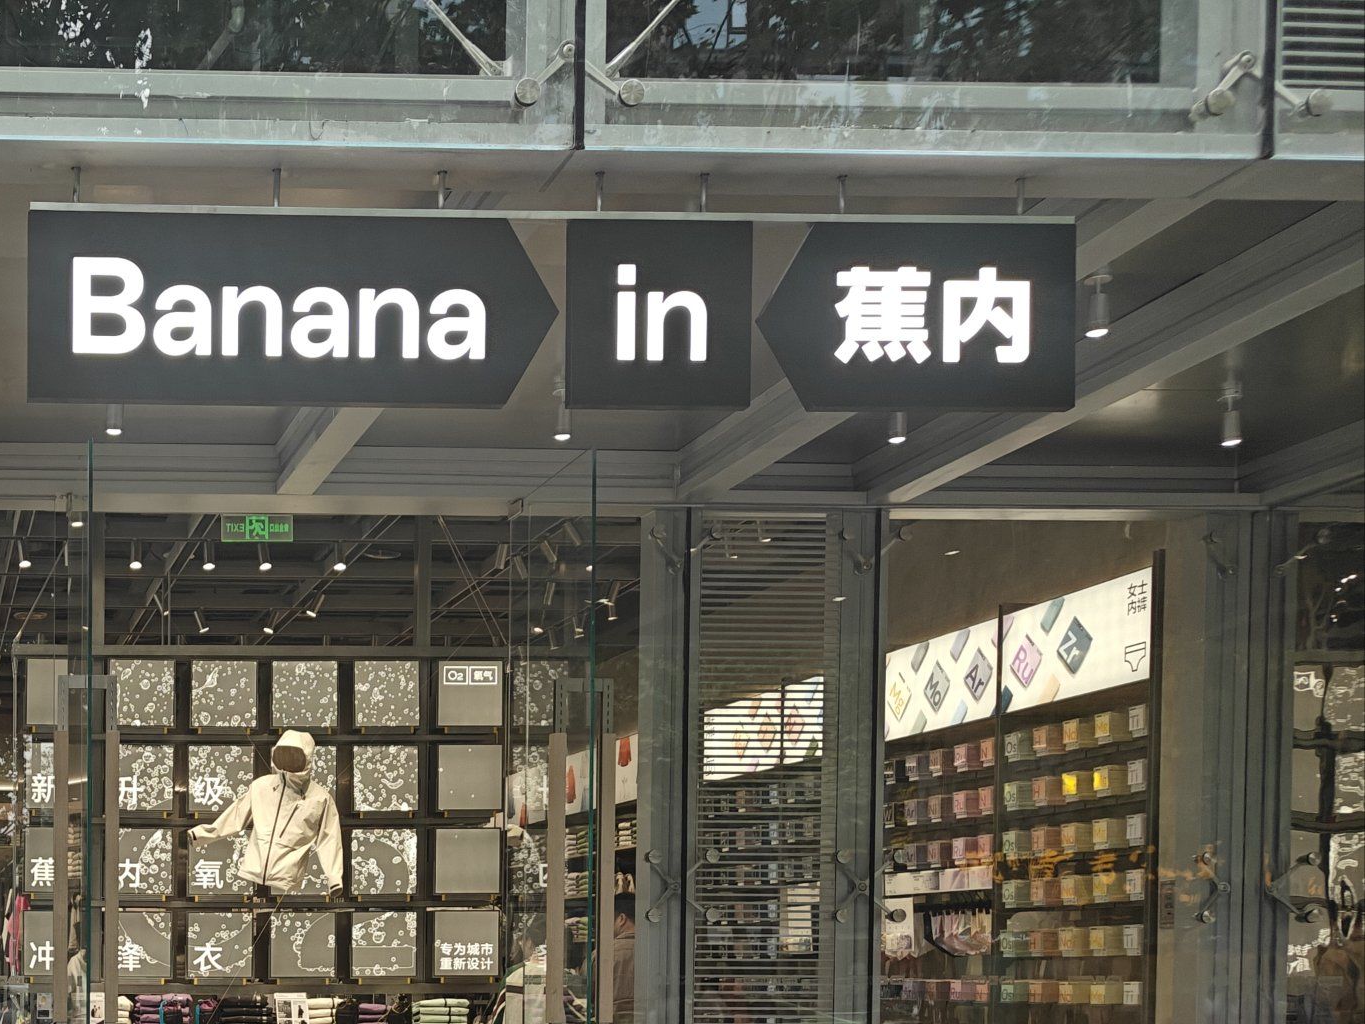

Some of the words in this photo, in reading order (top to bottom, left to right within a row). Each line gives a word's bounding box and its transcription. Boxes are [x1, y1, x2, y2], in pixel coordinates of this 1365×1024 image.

[70, 255, 487, 361] Banana
[616, 263, 708, 362] in
[834, 265, 1032, 366] 蕉内
[1127, 580, 1148, 599] 女士
[1060, 630, 1079, 662] Zr
[967, 662, 985, 694] Ar
[1011, 644, 1035, 684] Ru
[439, 942, 494, 956] 专为城市
[439, 957, 494, 970] 重新设计
